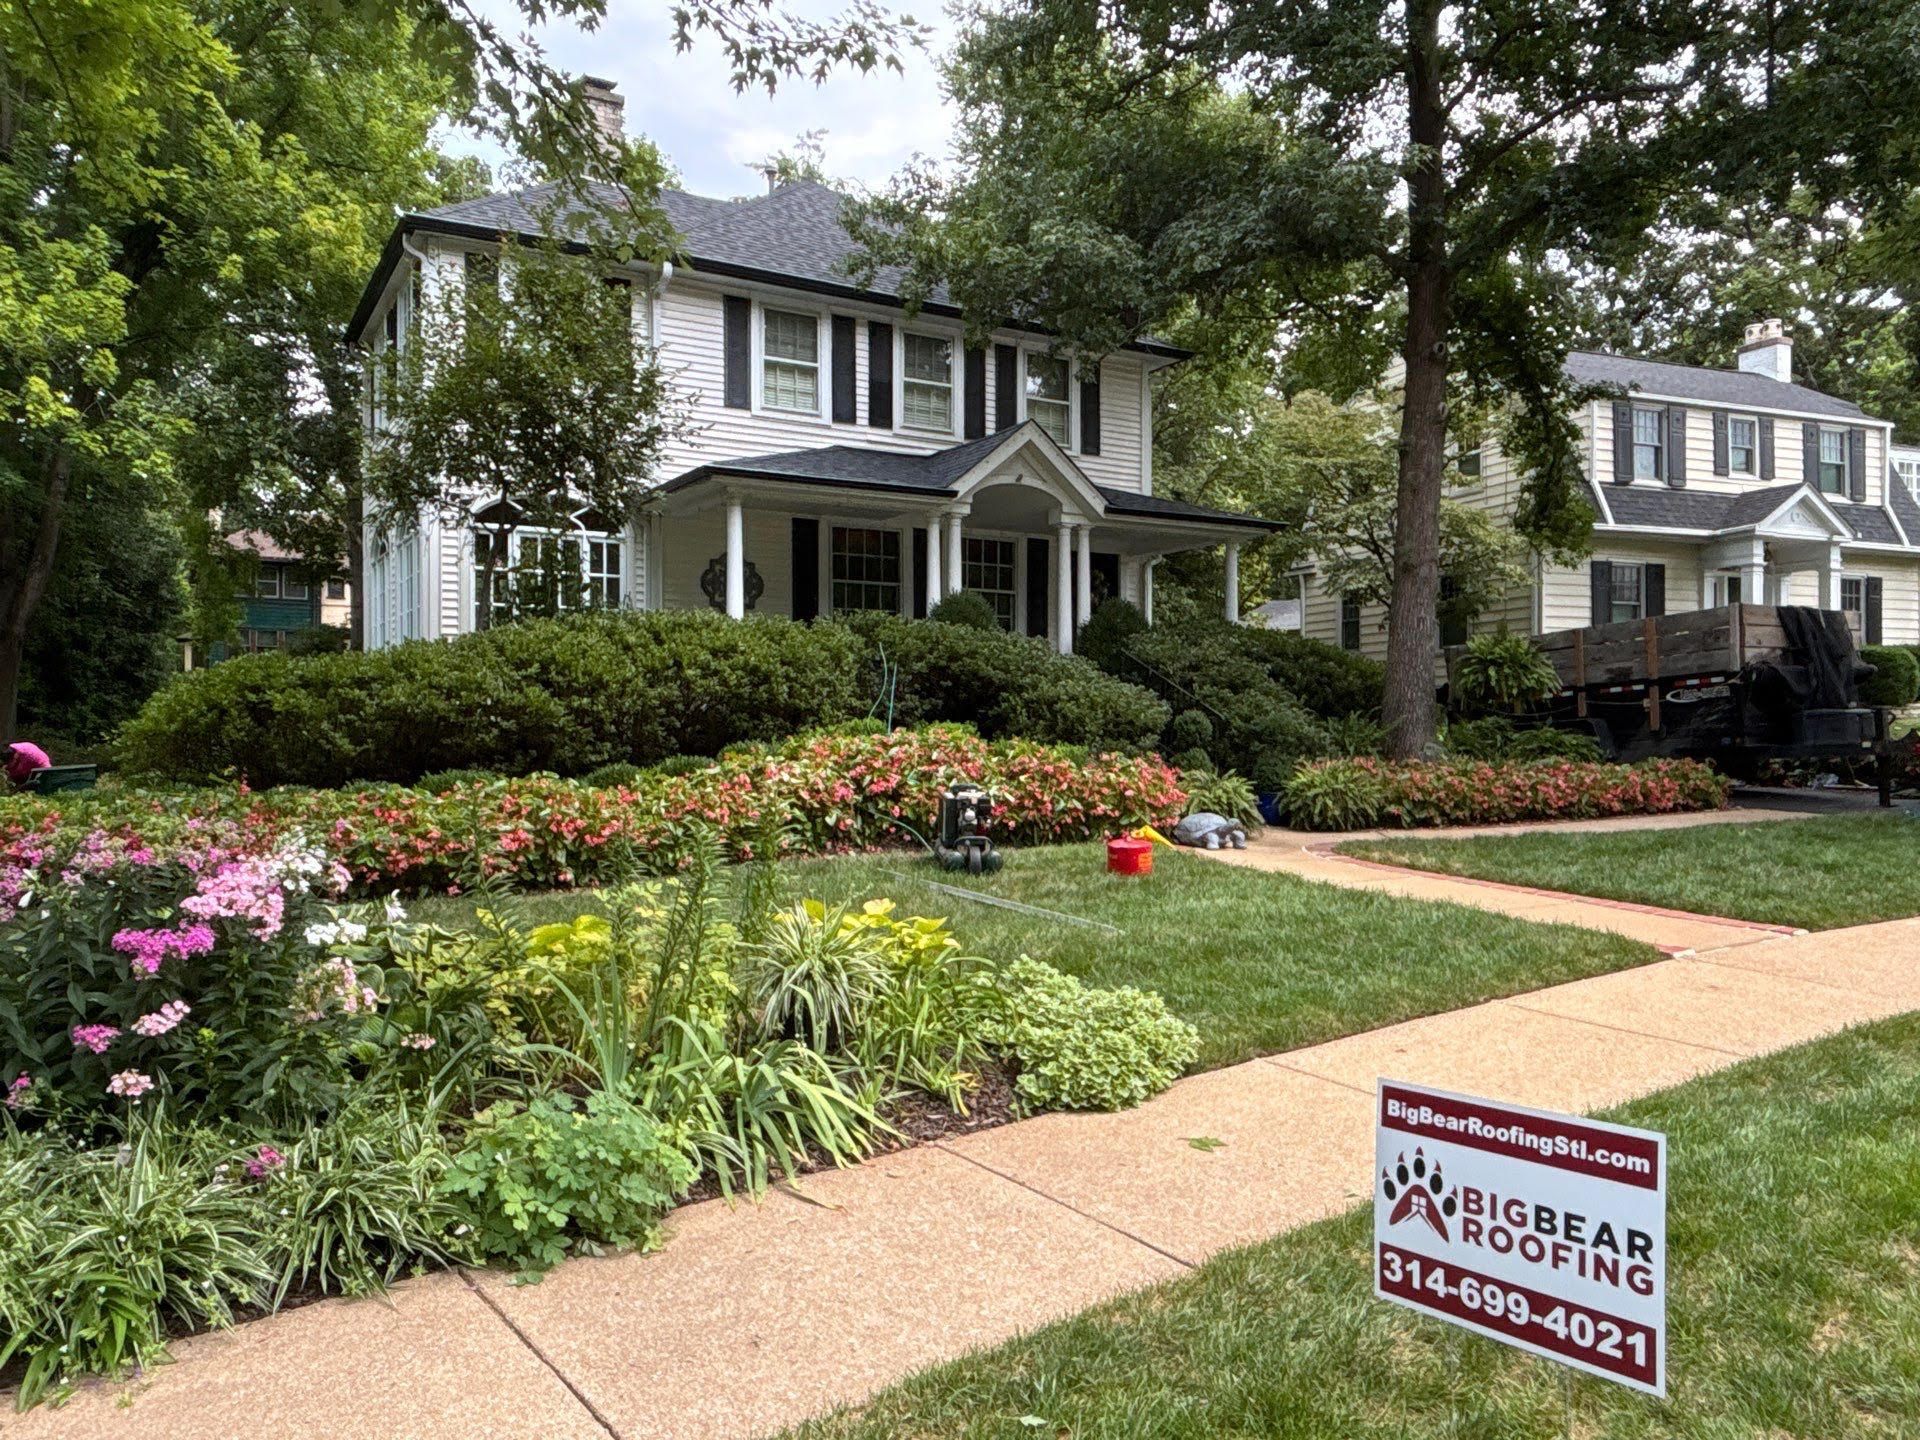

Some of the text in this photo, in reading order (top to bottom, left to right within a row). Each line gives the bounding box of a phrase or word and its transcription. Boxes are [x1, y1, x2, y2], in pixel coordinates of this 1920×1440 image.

[1387, 1099, 1650, 1173] BigBearRoofingStl.com
[1462, 1217, 1653, 1296] ROOFING
[1383, 1251, 1646, 1367] 314-699-4021
